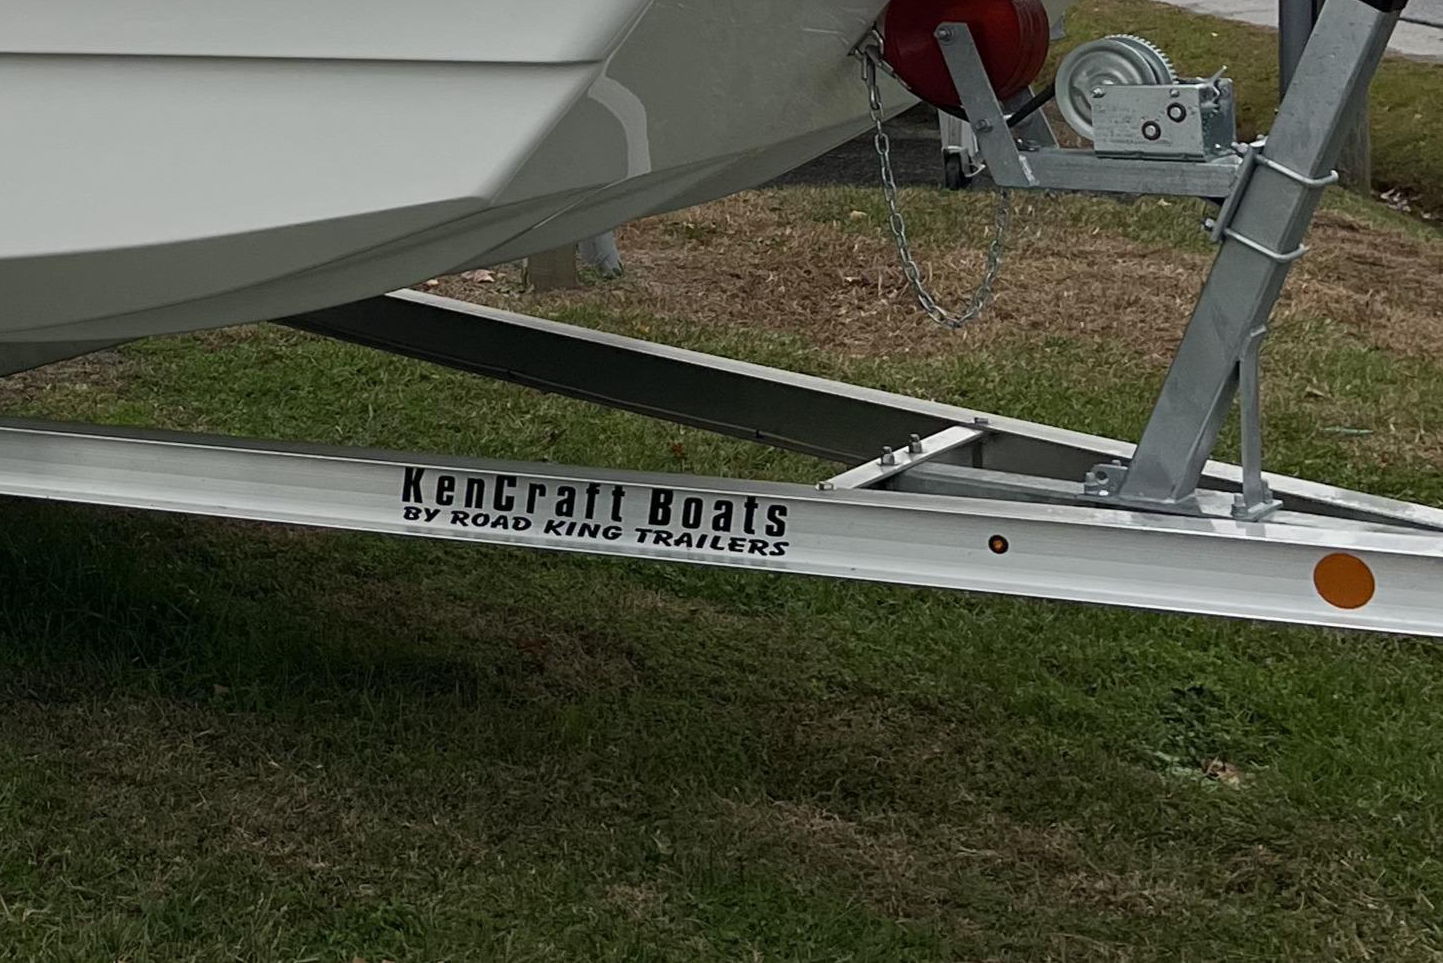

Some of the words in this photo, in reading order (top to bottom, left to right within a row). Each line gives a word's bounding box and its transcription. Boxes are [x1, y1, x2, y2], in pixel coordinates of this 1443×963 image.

[402, 467, 625, 523] KenCraft
[648, 488, 788, 537] Boats
[403, 506, 441, 522] BY
[450, 510, 532, 531] ROAD
[543, 519, 623, 541] KING
[634, 527, 790, 556] TRAILERS
